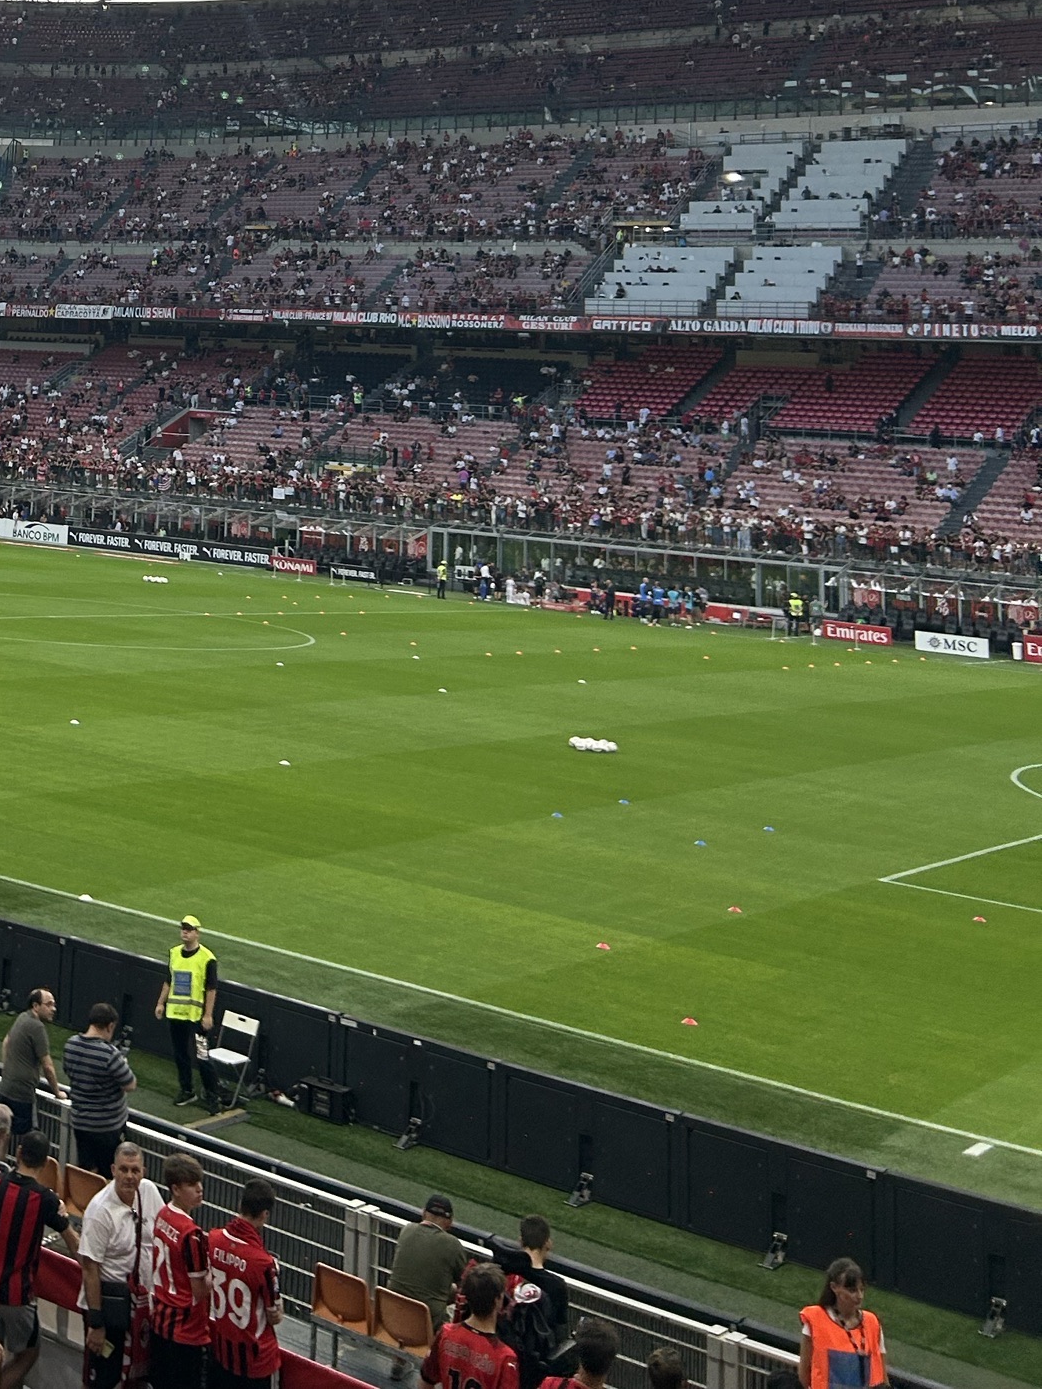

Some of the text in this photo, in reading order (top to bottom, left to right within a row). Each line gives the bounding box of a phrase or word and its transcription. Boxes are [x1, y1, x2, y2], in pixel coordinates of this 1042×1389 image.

[12, 309, 49, 318] PERINALDO
[56, 310, 100, 318] CAPRACOTTA
[135, 306, 151, 318] CLUB
[289, 310, 303, 320] CLUB
[332, 311, 397, 324] MILAN CLUB RHO
[417, 314, 451, 329] BIASSONO
[522, 321, 573, 330] GESTURI
[592, 319, 652, 332] GATTICO
[668, 320, 748, 332] ALTO GARDA
[747, 319, 774, 334] MILAN
[773, 319, 795, 334] CLUB
[923, 323, 980, 337] PINETO
[1000, 325, 1037, 336] MELZO
[12, 529, 60, 543] BANCO BPM
[78, 533, 131, 548] FOREVER. FASTER.
[143, 539, 200, 556] FOREVER. FASTER.
[212, 547, 272, 565] FOREVER. FASTER.
[272, 558, 314, 574] KONAMI
[826, 623, 888, 644] Emirates
[943, 638, 978, 653] MSC
[213, 1247, 247, 1272] FILIPPO
[209, 1266, 252, 1330] 39
